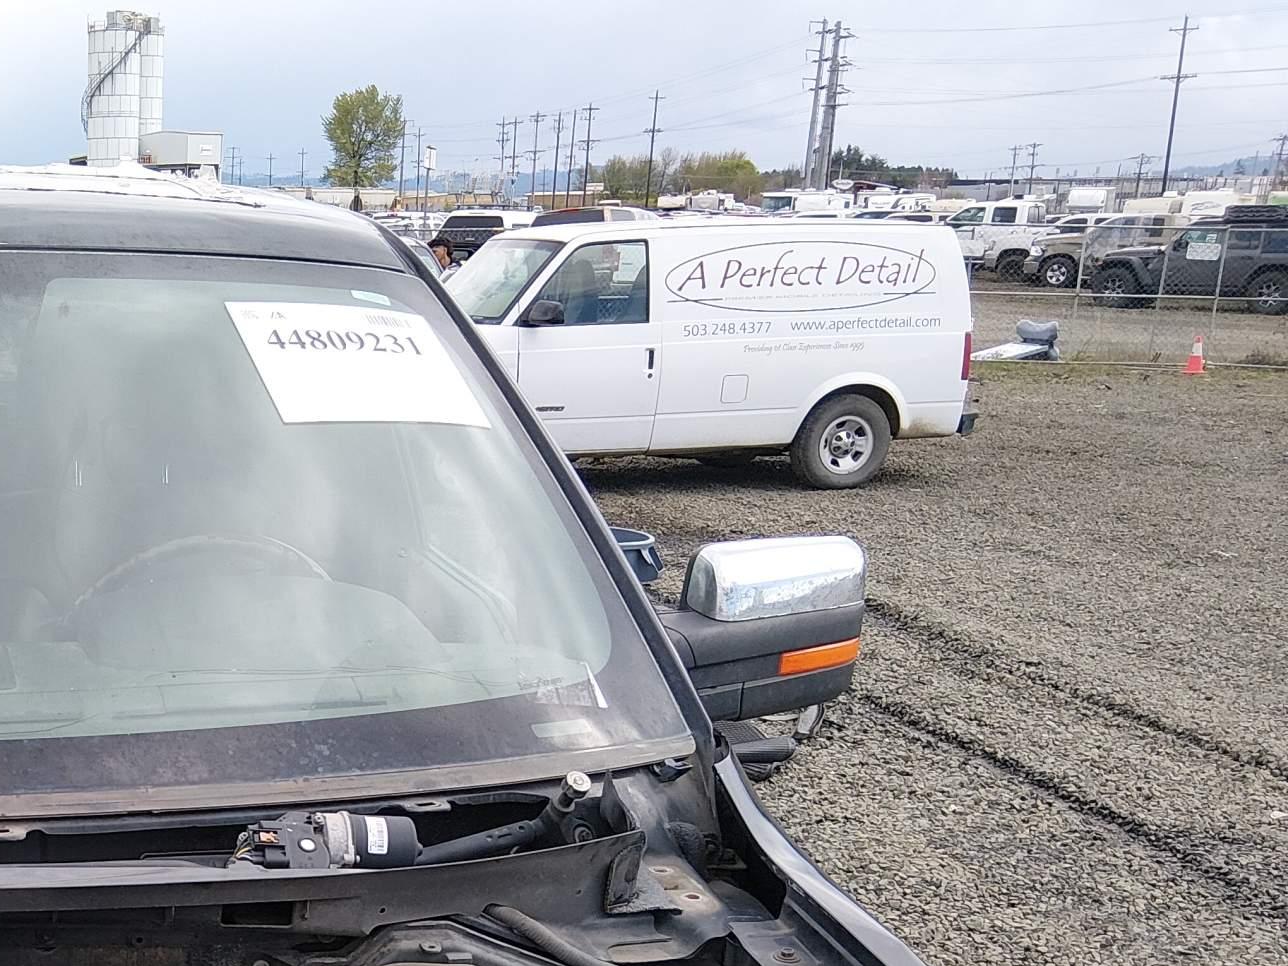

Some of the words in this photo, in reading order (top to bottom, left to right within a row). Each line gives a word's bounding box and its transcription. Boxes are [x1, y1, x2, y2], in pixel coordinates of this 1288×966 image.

[677, 260, 706, 291] A
[720, 249, 828, 288] Perfect
[835, 248, 924, 286] Detail
[683, 321, 772, 337] 503.248.4377
[790, 316, 941, 332] www.aperfectdetail.com
[267, 328, 423, 356] 44809231
